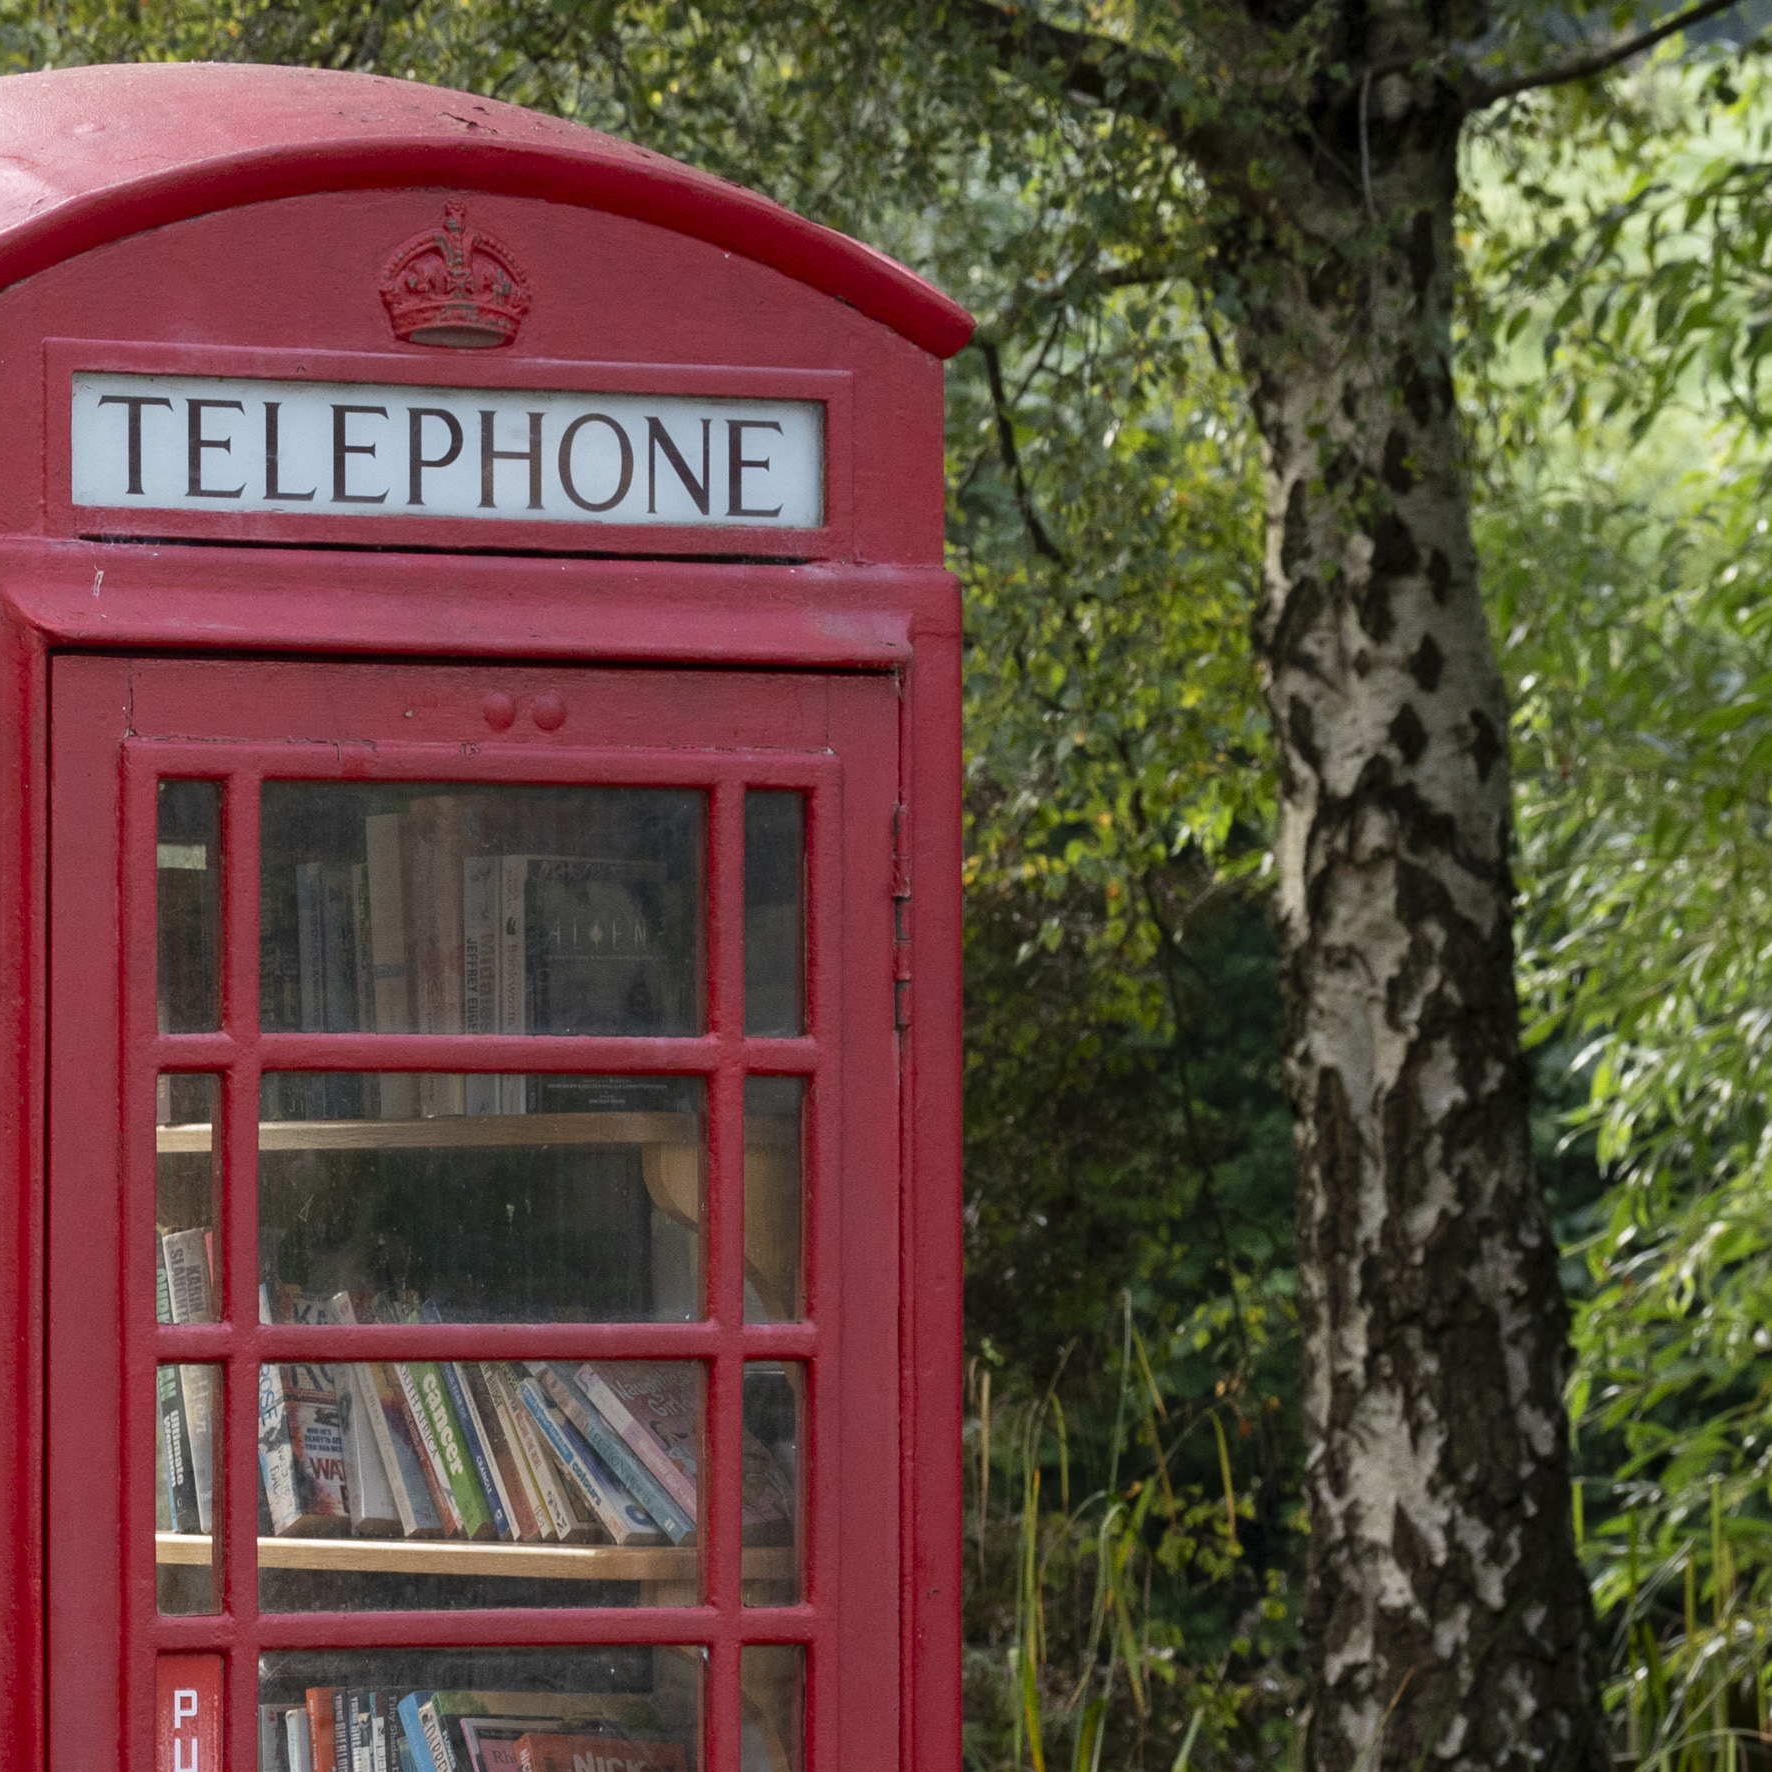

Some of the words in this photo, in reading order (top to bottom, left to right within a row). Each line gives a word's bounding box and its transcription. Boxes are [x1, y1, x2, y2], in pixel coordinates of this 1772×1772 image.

[97, 395, 785, 518] TELEPHONE
[169, 1409, 184, 1486] Ultimate
[423, 1373, 463, 1475] cancer
[572, 1462, 602, 1506] colours
[389, 1696, 397, 1721] Fifty
[390, 1725, 398, 1764] Shades
